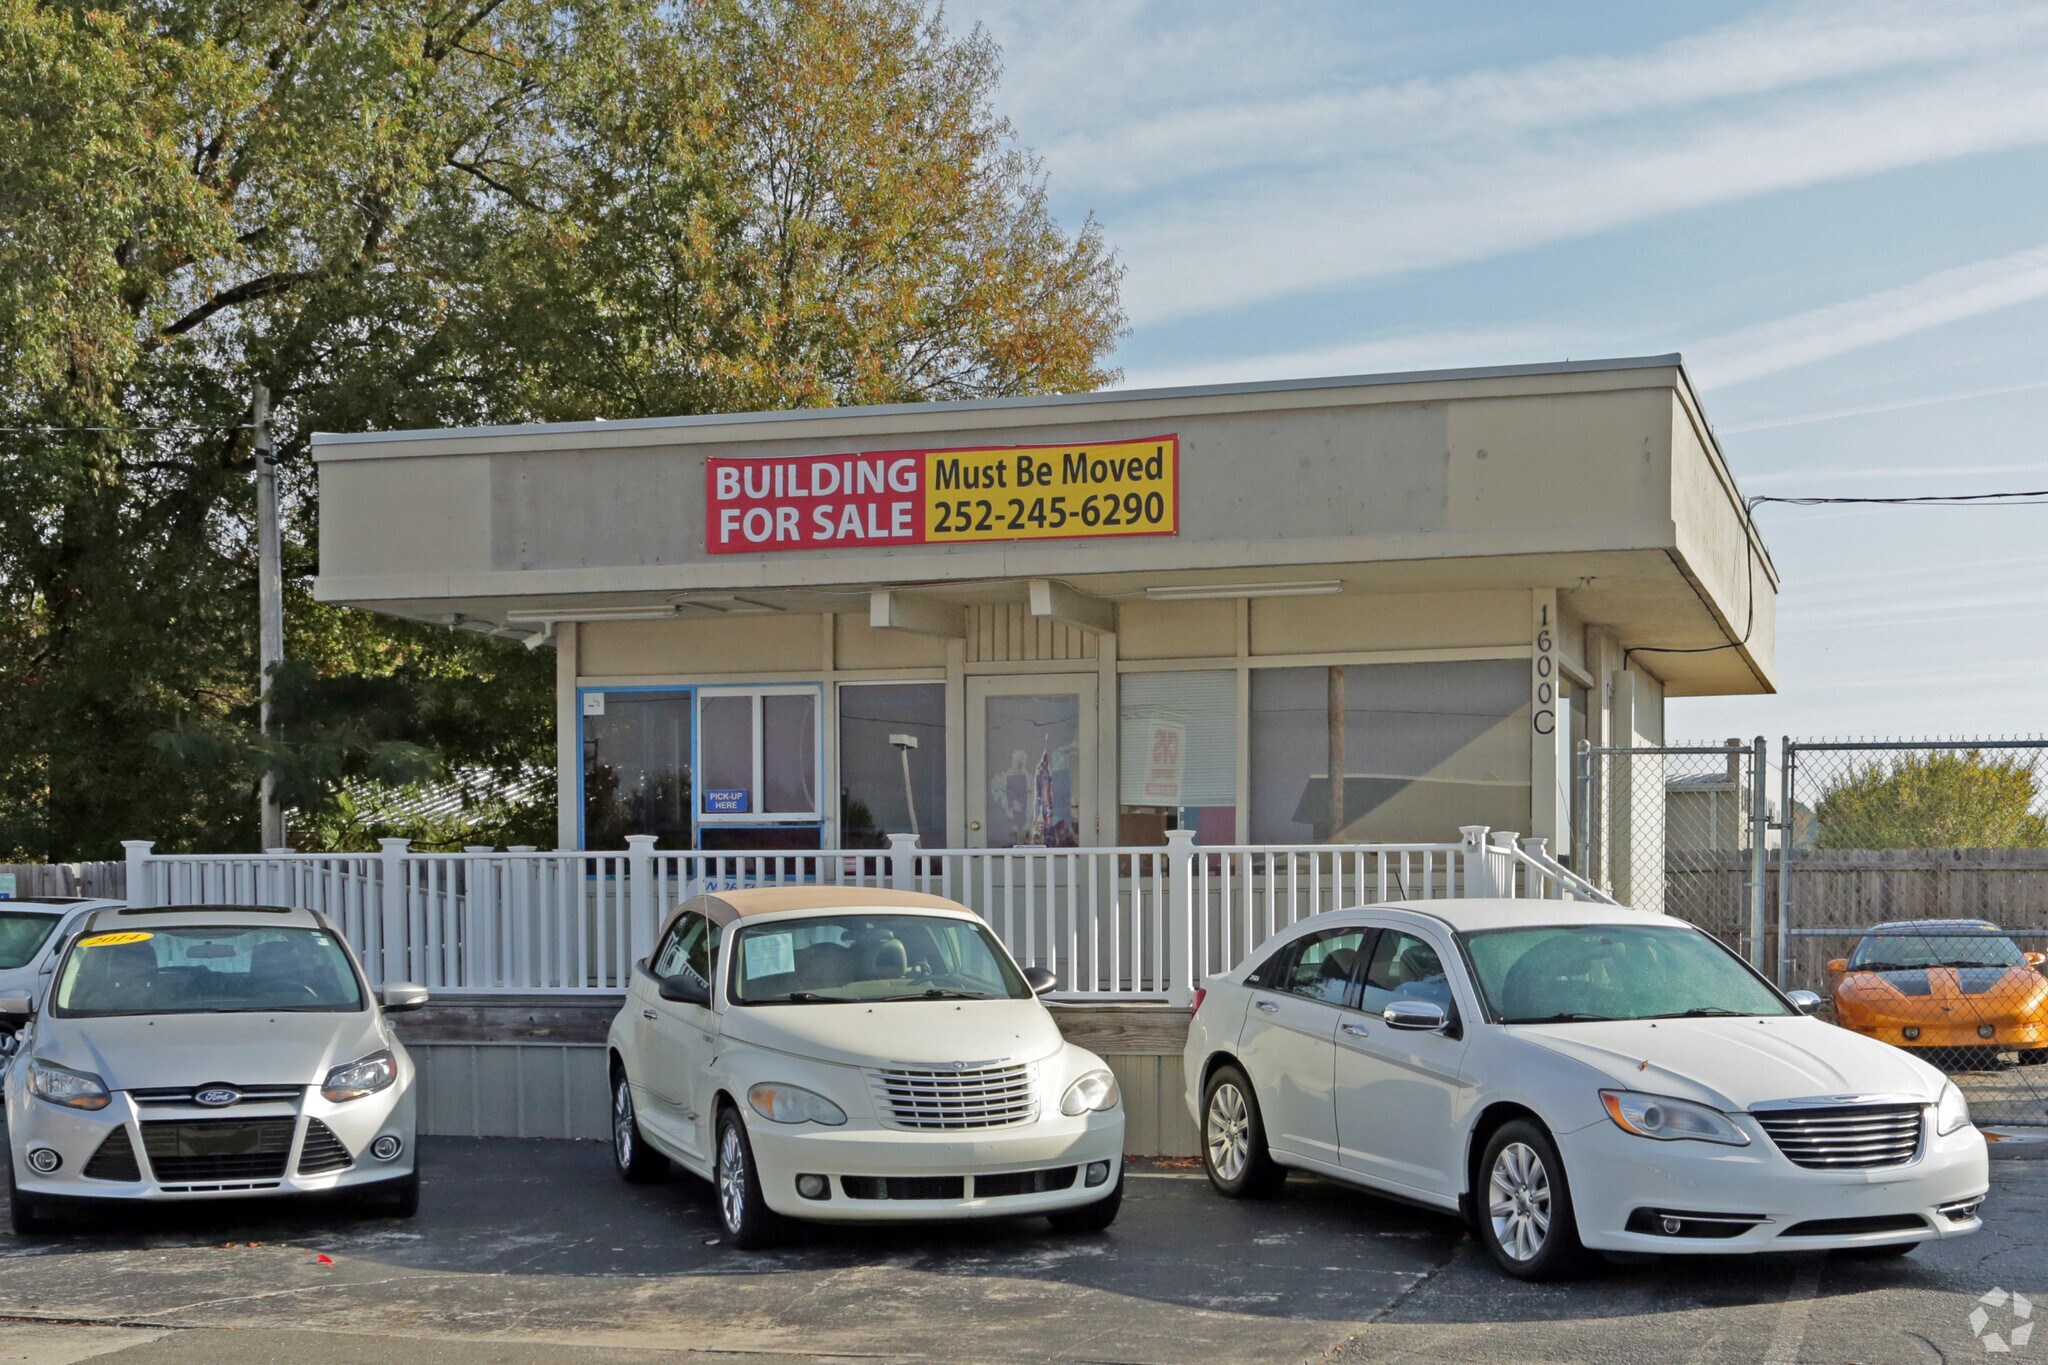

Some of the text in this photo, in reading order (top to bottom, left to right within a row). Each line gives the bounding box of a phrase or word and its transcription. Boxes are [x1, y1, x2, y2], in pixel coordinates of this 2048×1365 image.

[717, 458, 917, 500] BUILDING
[935, 446, 1163, 490] Must Be Moved
[720, 502, 913, 543] FOR SALE
[934, 491, 1164, 533] 252-245-6290
[715, 801, 738, 809] HERE
[88, 934, 143, 945] 2014
[205, 1091, 230, 1101] Ford
